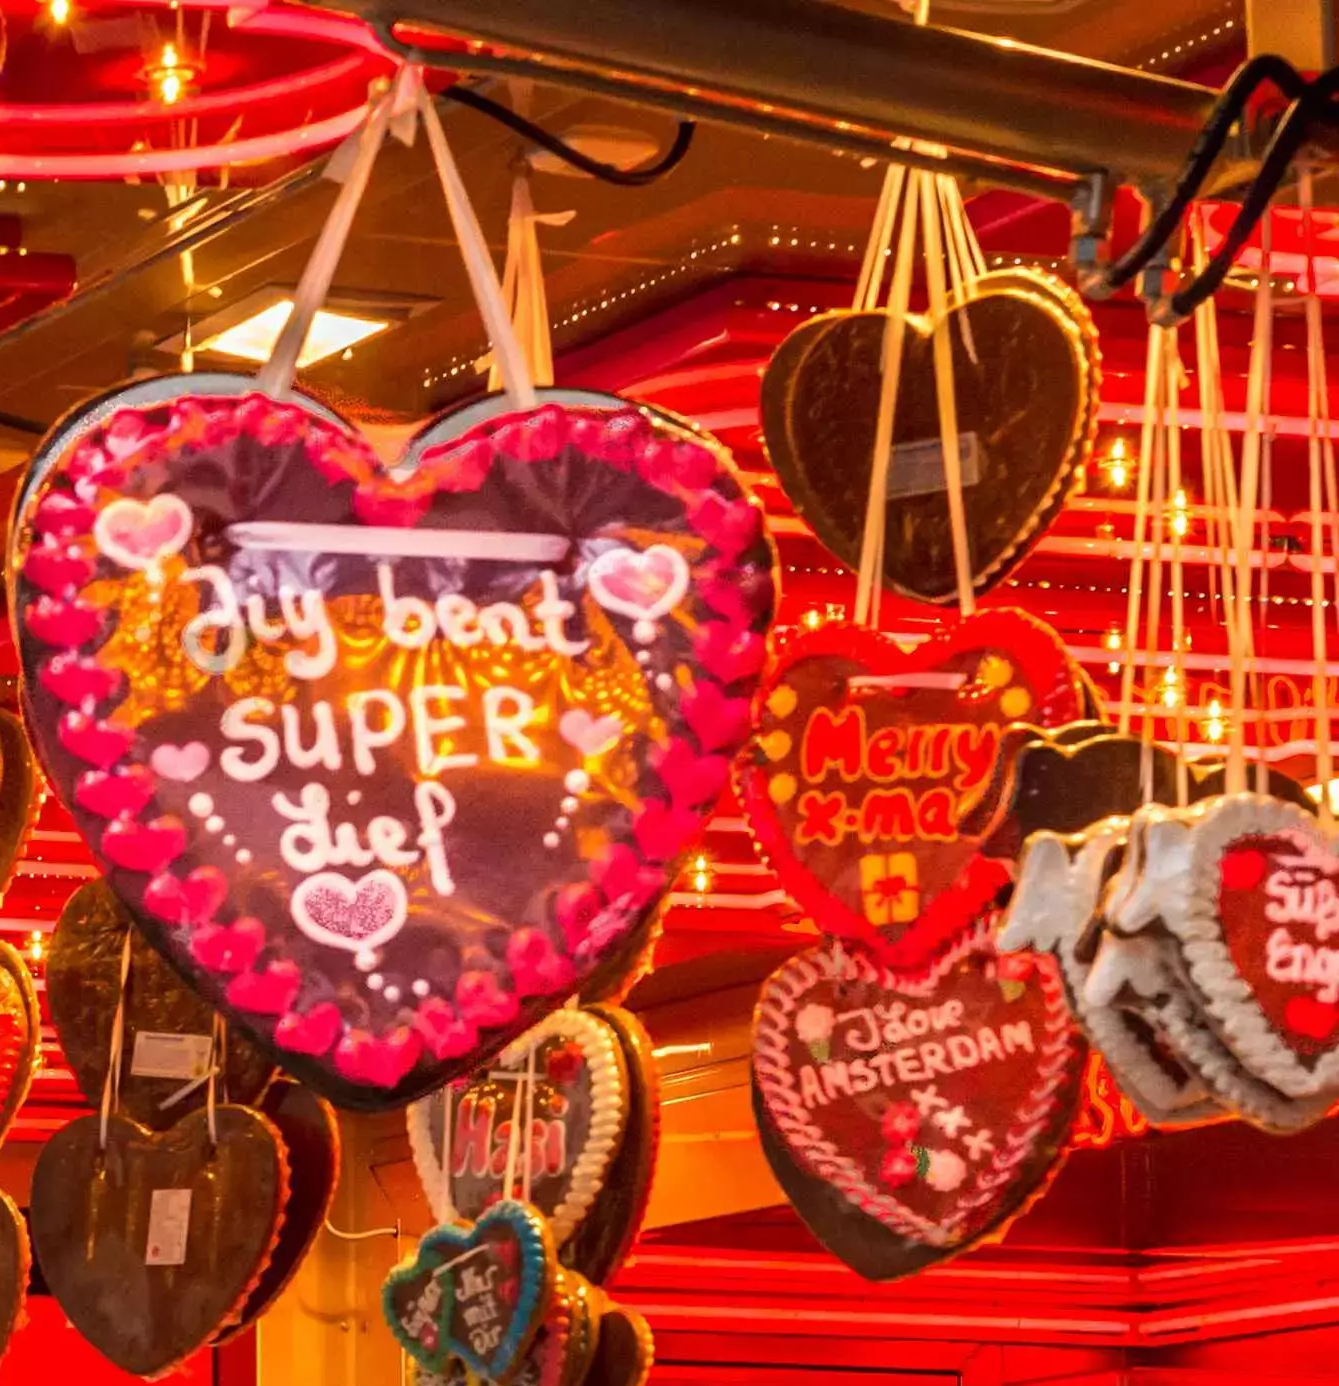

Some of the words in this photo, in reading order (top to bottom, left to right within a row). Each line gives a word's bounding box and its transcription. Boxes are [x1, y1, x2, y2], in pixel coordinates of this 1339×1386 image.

[377, 561, 591, 656] bent
[219, 685, 541, 782] SUPER
[800, 705, 1003, 792] Merry
[799, 1020, 1035, 1109] AMSTERDAM
